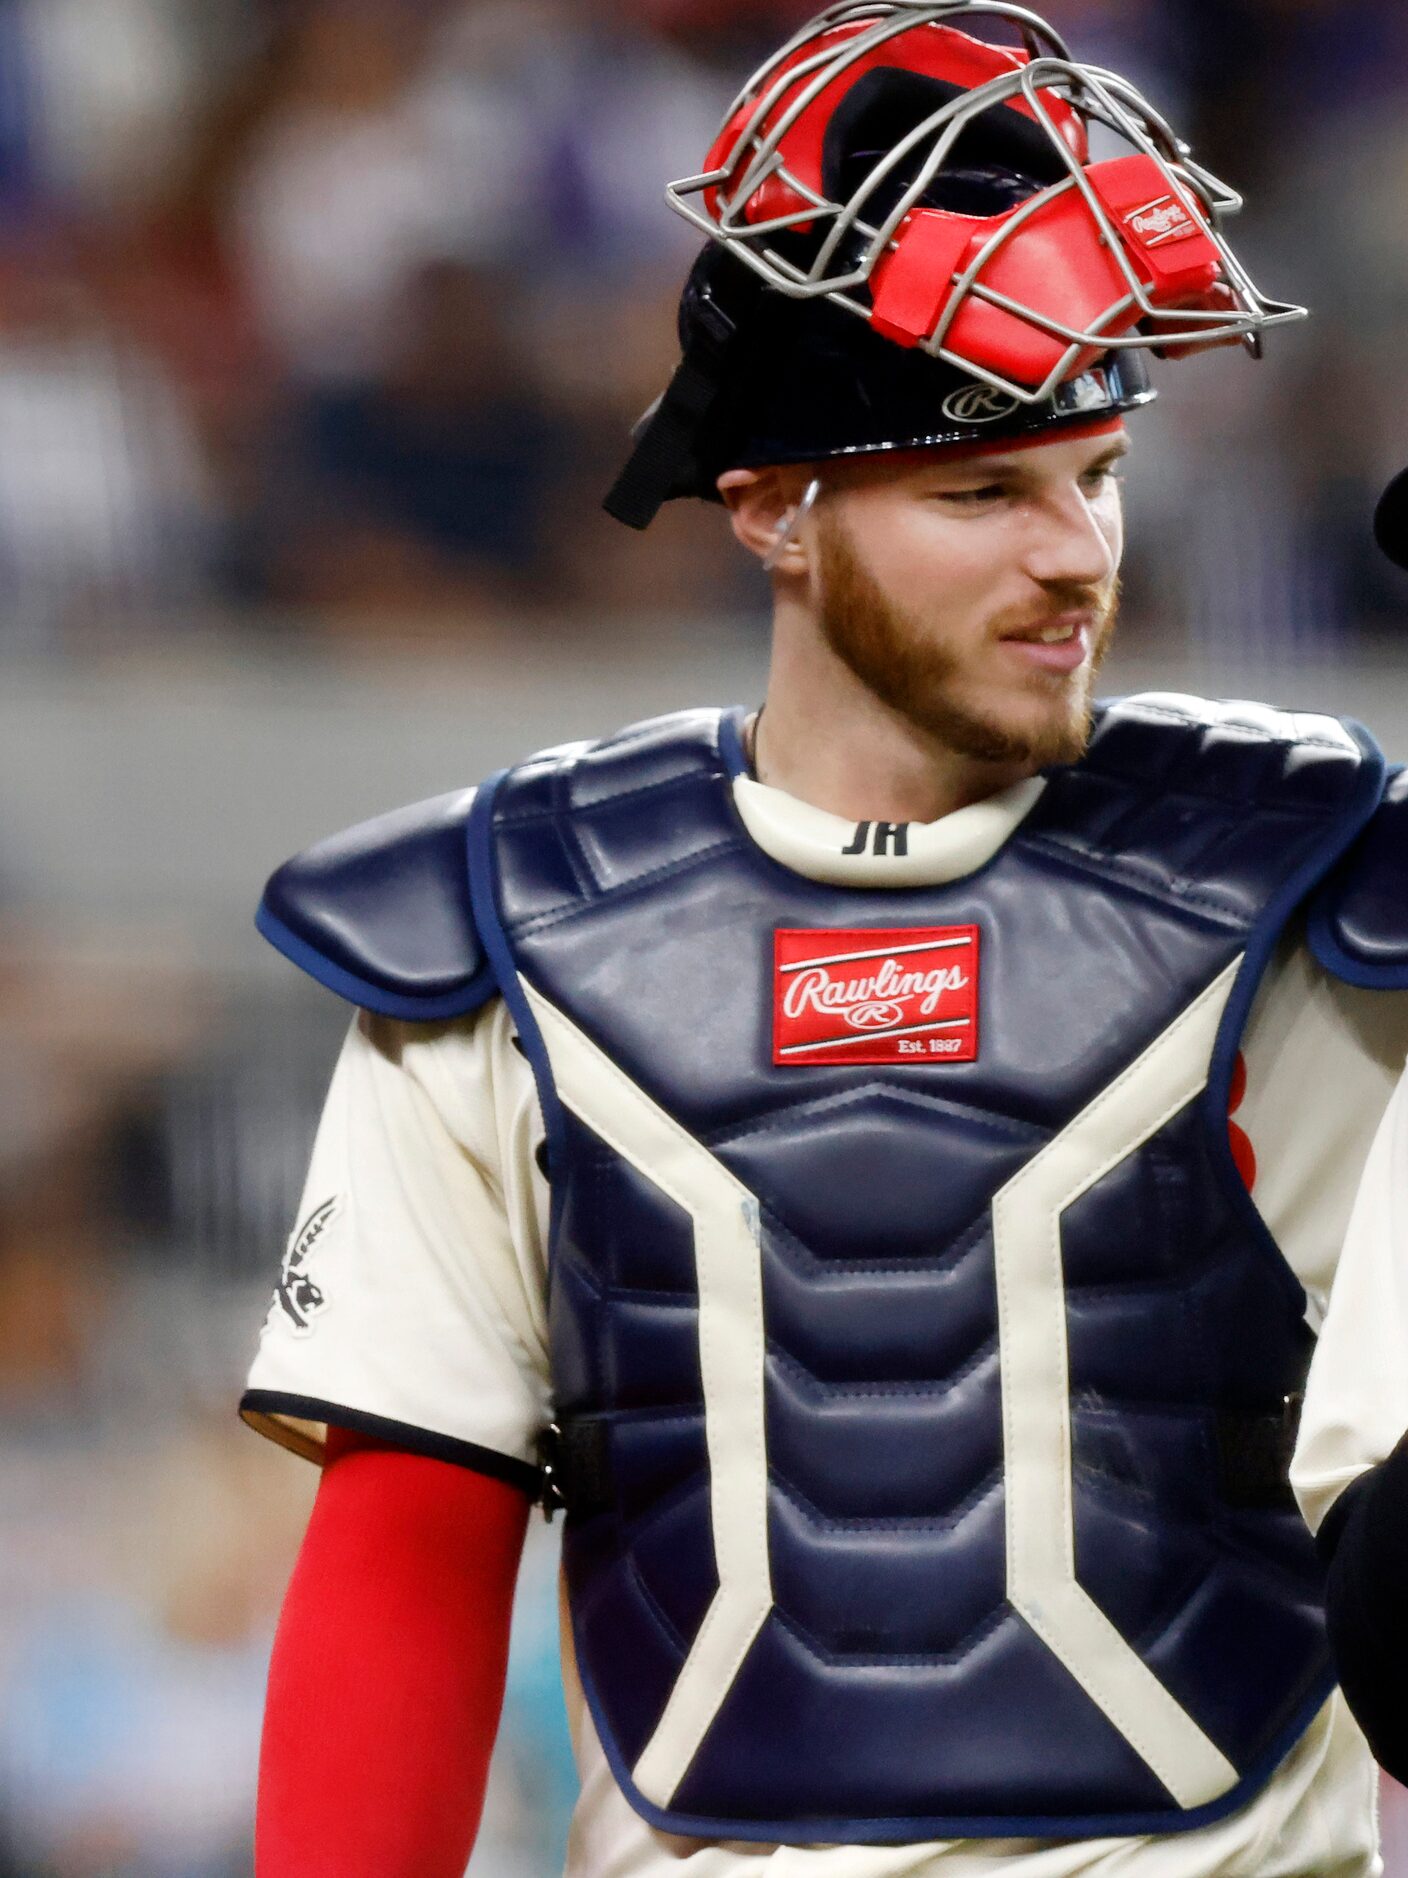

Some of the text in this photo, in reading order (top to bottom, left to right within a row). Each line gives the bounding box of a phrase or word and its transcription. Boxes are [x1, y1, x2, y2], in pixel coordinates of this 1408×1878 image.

[784, 960, 969, 1018] Rawlings
[897, 1037, 963, 1054] Est. 1887
